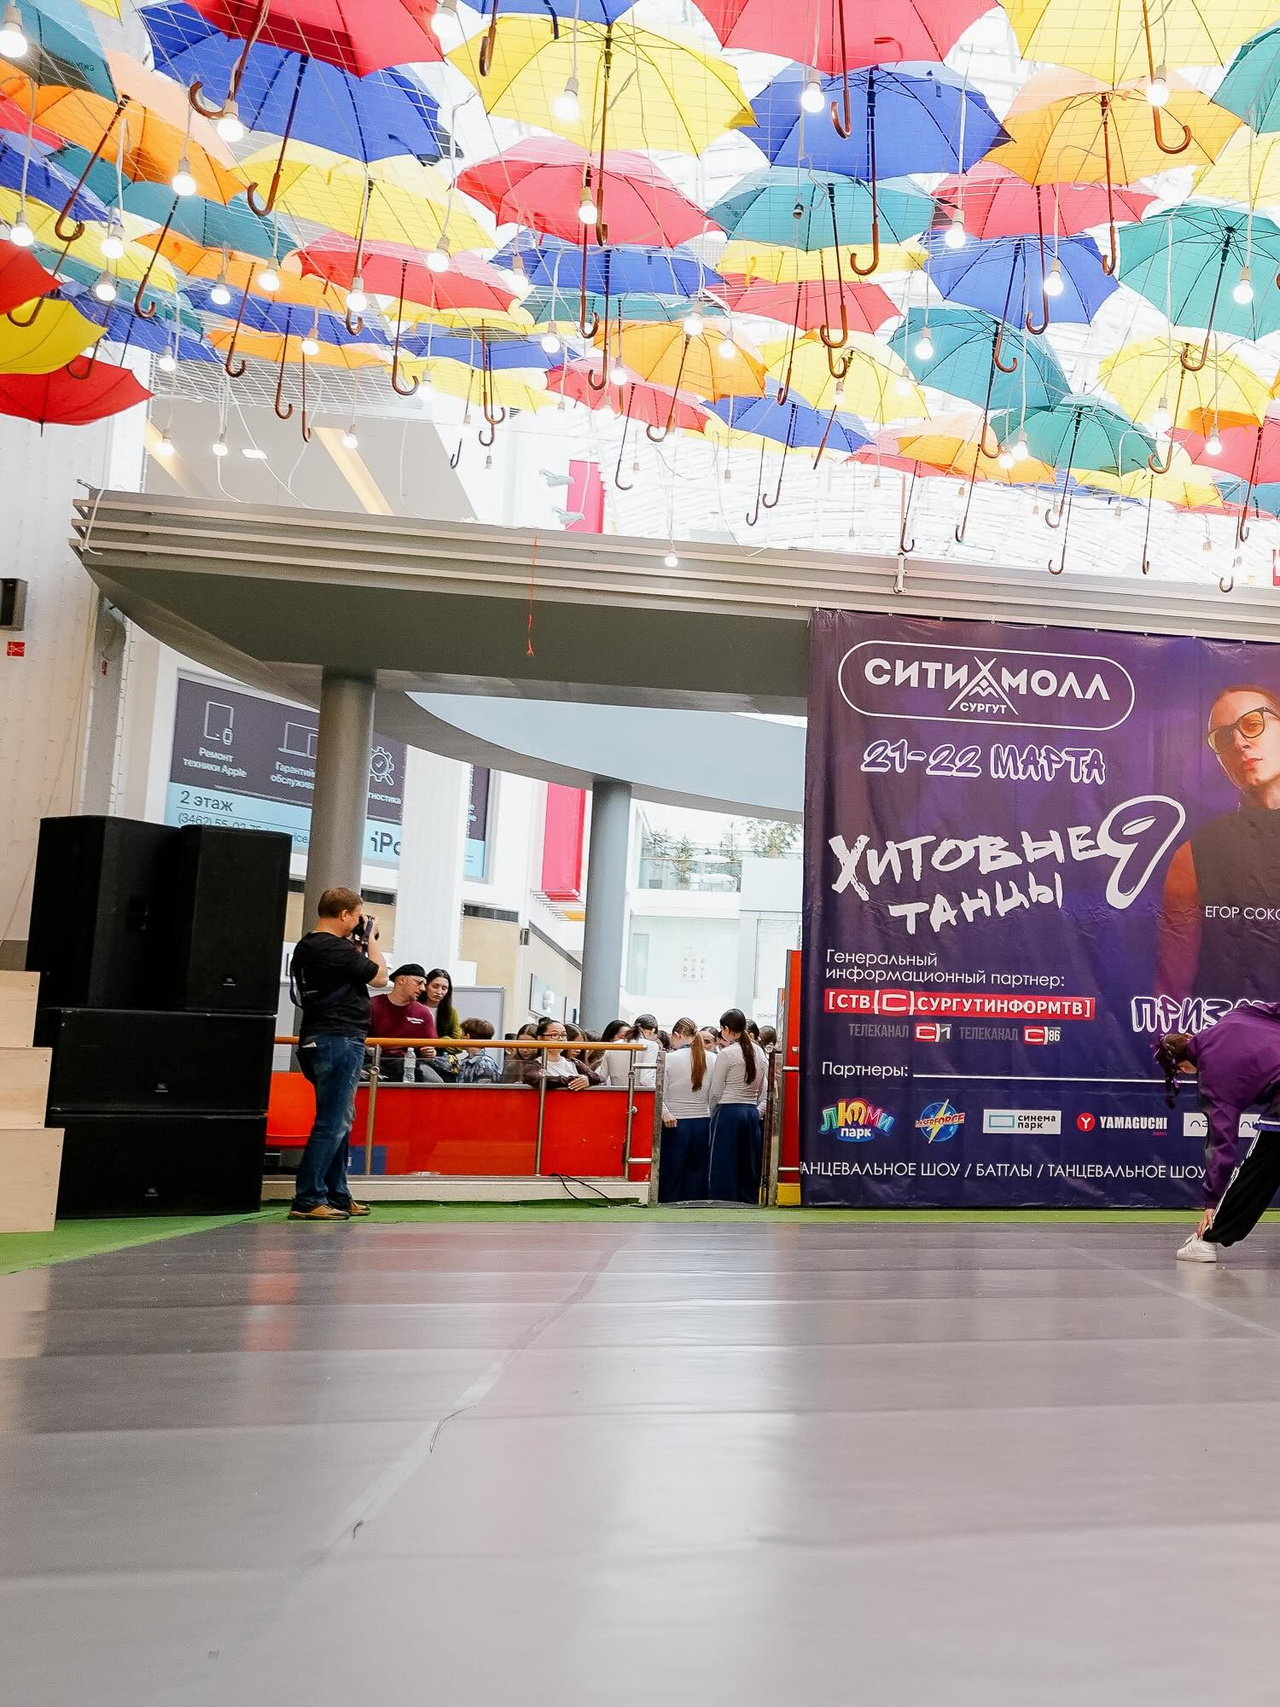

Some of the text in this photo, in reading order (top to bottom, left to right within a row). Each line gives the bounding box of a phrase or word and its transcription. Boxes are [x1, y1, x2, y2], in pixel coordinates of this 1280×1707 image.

[959, 701, 1007, 715] СУРГУТ
[198, 746, 234, 763] Ремонт
[860, 738, 1107, 785] 21-22 МАРТА
[182, 757, 248, 778] техники Apple
[275, 760, 316, 778] Гарантий
[180, 790, 234, 813] 2 этаж
[368, 792, 402, 805] гностика
[888, 871, 1064, 936] ТАНЦЫ
[1204, 905, 1240, 919] ЕГОР
[826, 949, 938, 967] Генеральный
[825, 966, 1066, 989] информационный партнер:
[848, 1023, 909, 1038] ТЕЛЕКАНАЛ
[959, 1026, 1019, 1041] ТЕЛЕКАНАЛ
[822, 1061, 908, 1079] Партнеры:
[1017, 1114, 1056, 1123] синема
[1017, 1122, 1044, 1130] парк
[1100, 1115, 1168, 1130] YAMAGUCHI
[840, 1126, 872, 1140] парк
[920, 1162, 961, 1177] ШОУ
[976, 1163, 1033, 1177] БАТТЛЫ
[1048, 1164, 1167, 1179] ТАНЦЕВАЛЬНОЕ
[1170, 1165, 1207, 1179] ШОУ
